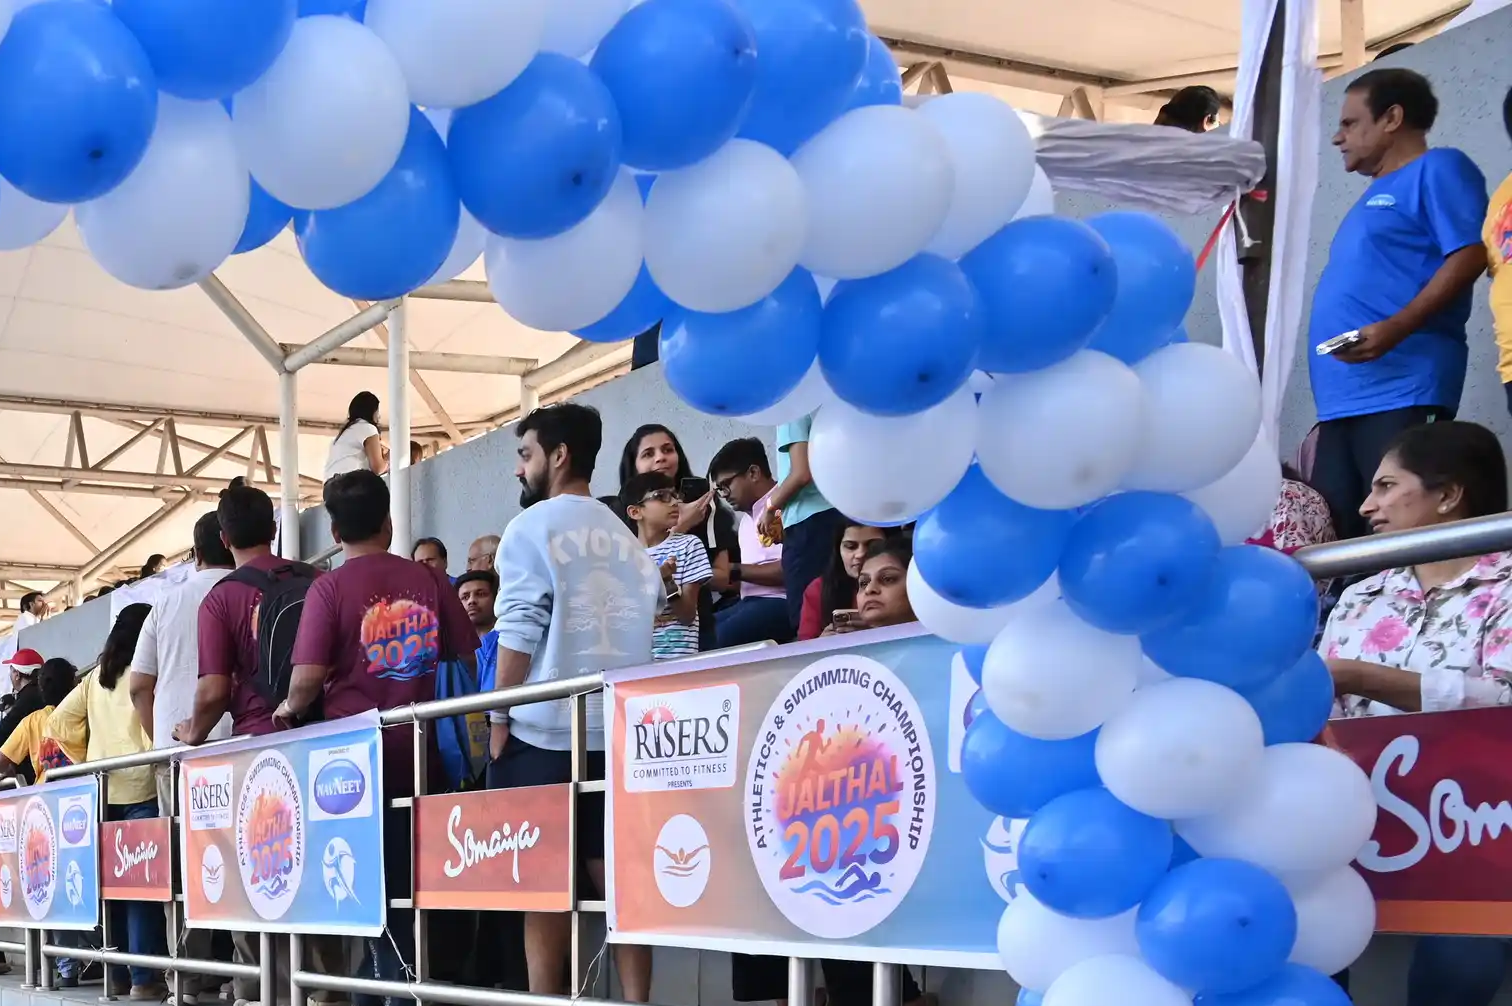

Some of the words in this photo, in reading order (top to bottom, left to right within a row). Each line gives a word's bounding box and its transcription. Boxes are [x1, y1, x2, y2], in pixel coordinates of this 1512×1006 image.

[367, 630, 438, 673] 2025
[633, 714, 730, 760] RISERS
[752, 731, 777, 849] ATHLETICS
[774, 715, 785, 730] &
[784, 668, 871, 714] SWIMMING
[873, 680, 926, 850] CHAMPIONSHIP
[633, 767, 679, 779] COMMITTED
[681, 766, 691, 775] TO
[694, 763, 727, 775] FITNESS
[668, 780, 693, 788] PRESENTS
[778, 755, 904, 820] JALTHAL
[191, 782, 230, 811] RISERS
[114, 828, 158, 883] Somaiya
[250, 838, 294, 885] 2025
[444, 804, 540, 884] Somaiya
[779, 800, 900, 881] 2025
